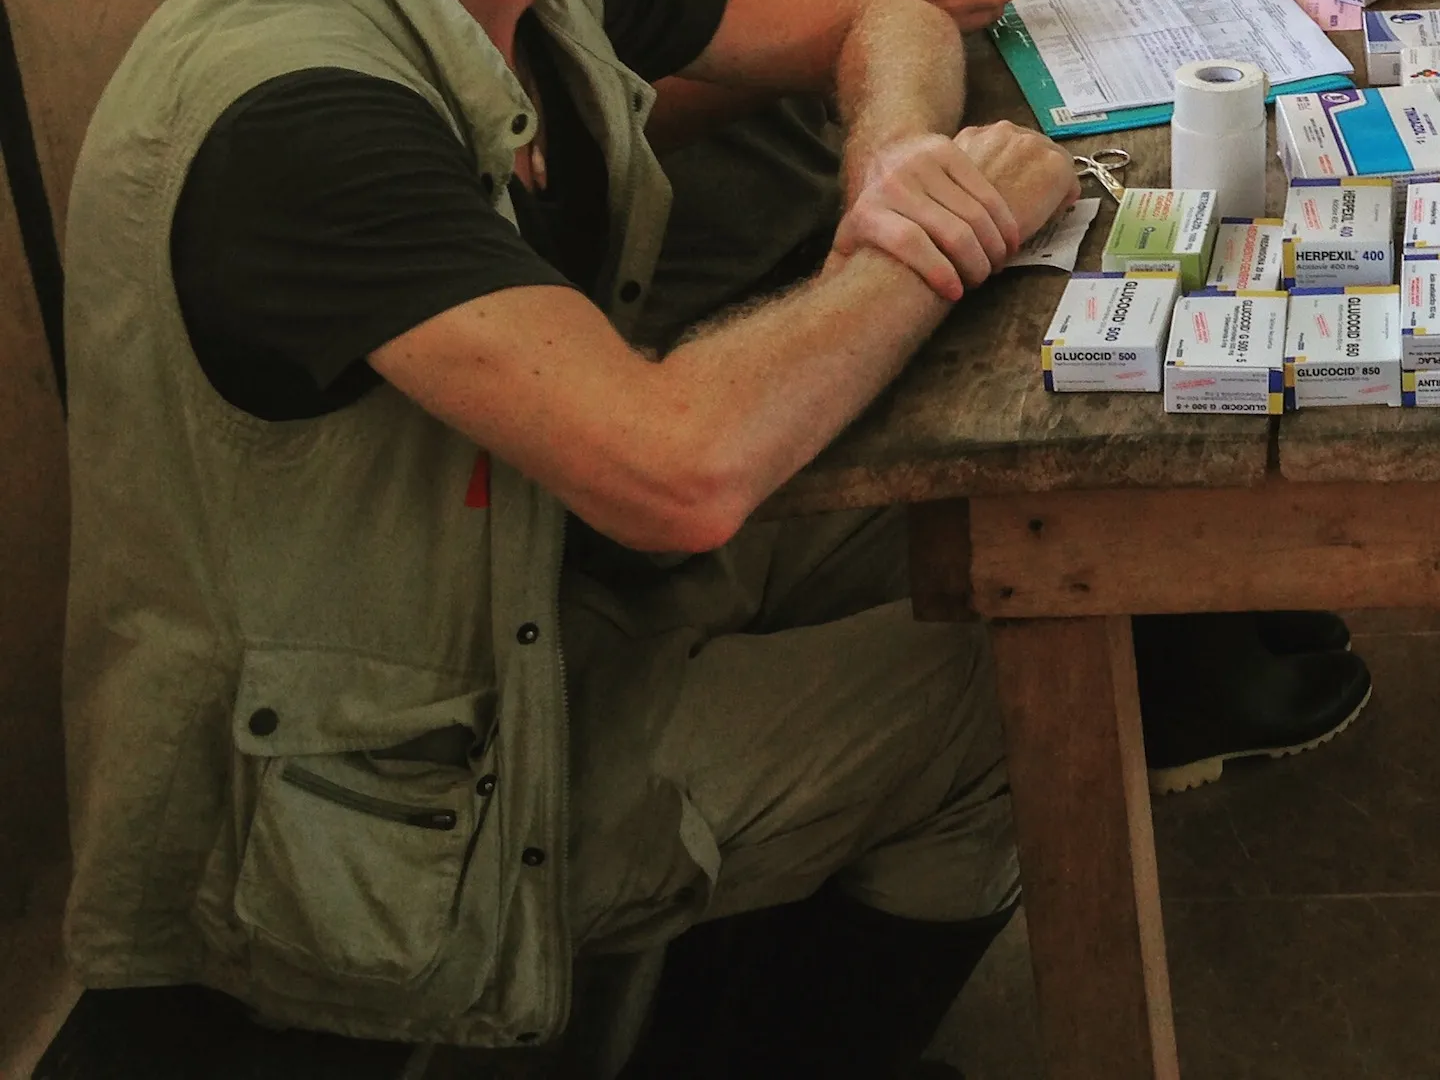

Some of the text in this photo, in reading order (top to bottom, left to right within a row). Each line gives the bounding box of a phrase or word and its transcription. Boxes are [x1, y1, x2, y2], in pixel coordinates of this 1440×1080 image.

[1340, 190, 1356, 223] HERPEXIL
[1296, 251, 1385, 261] HERPEXIL 400
[1105, 281, 1138, 342] GLUCOCID 500
[1240, 299, 1253, 331] GLUCOCID
[1346, 297, 1361, 357] GLUCOCID 850
[1237, 340, 1248, 351] 500
[1054, 352, 1136, 361] GLUCOCID 500
[1297, 367, 1380, 377] GLUCOCID 850
